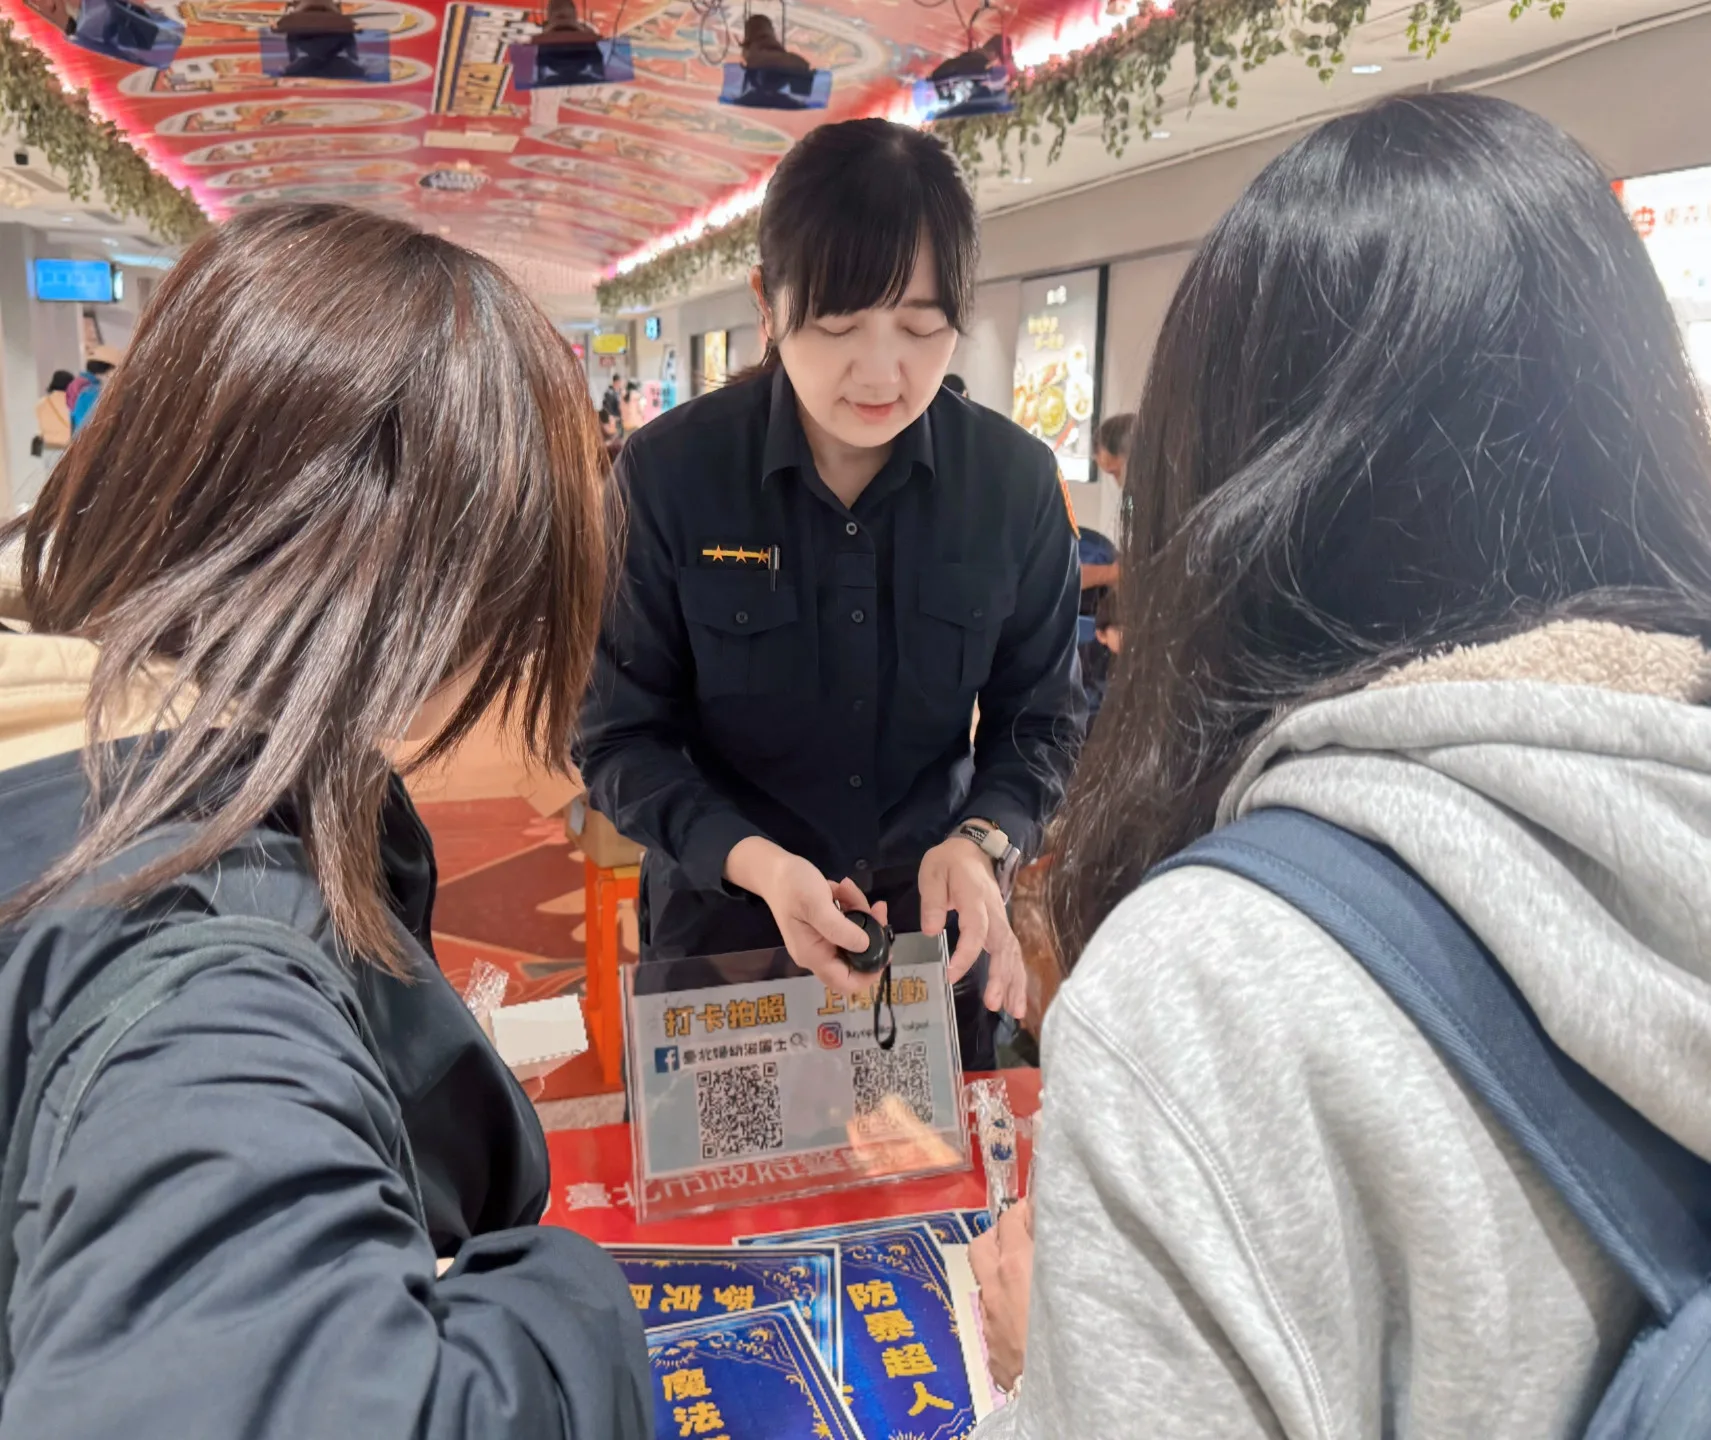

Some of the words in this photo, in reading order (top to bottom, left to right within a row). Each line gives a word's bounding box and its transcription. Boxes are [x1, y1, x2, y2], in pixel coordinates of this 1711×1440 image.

[663, 993, 787, 1037] 打卡拍照
[846, 1279, 954, 1416] 防暴超人
[662, 1368, 731, 1440] 魔法
